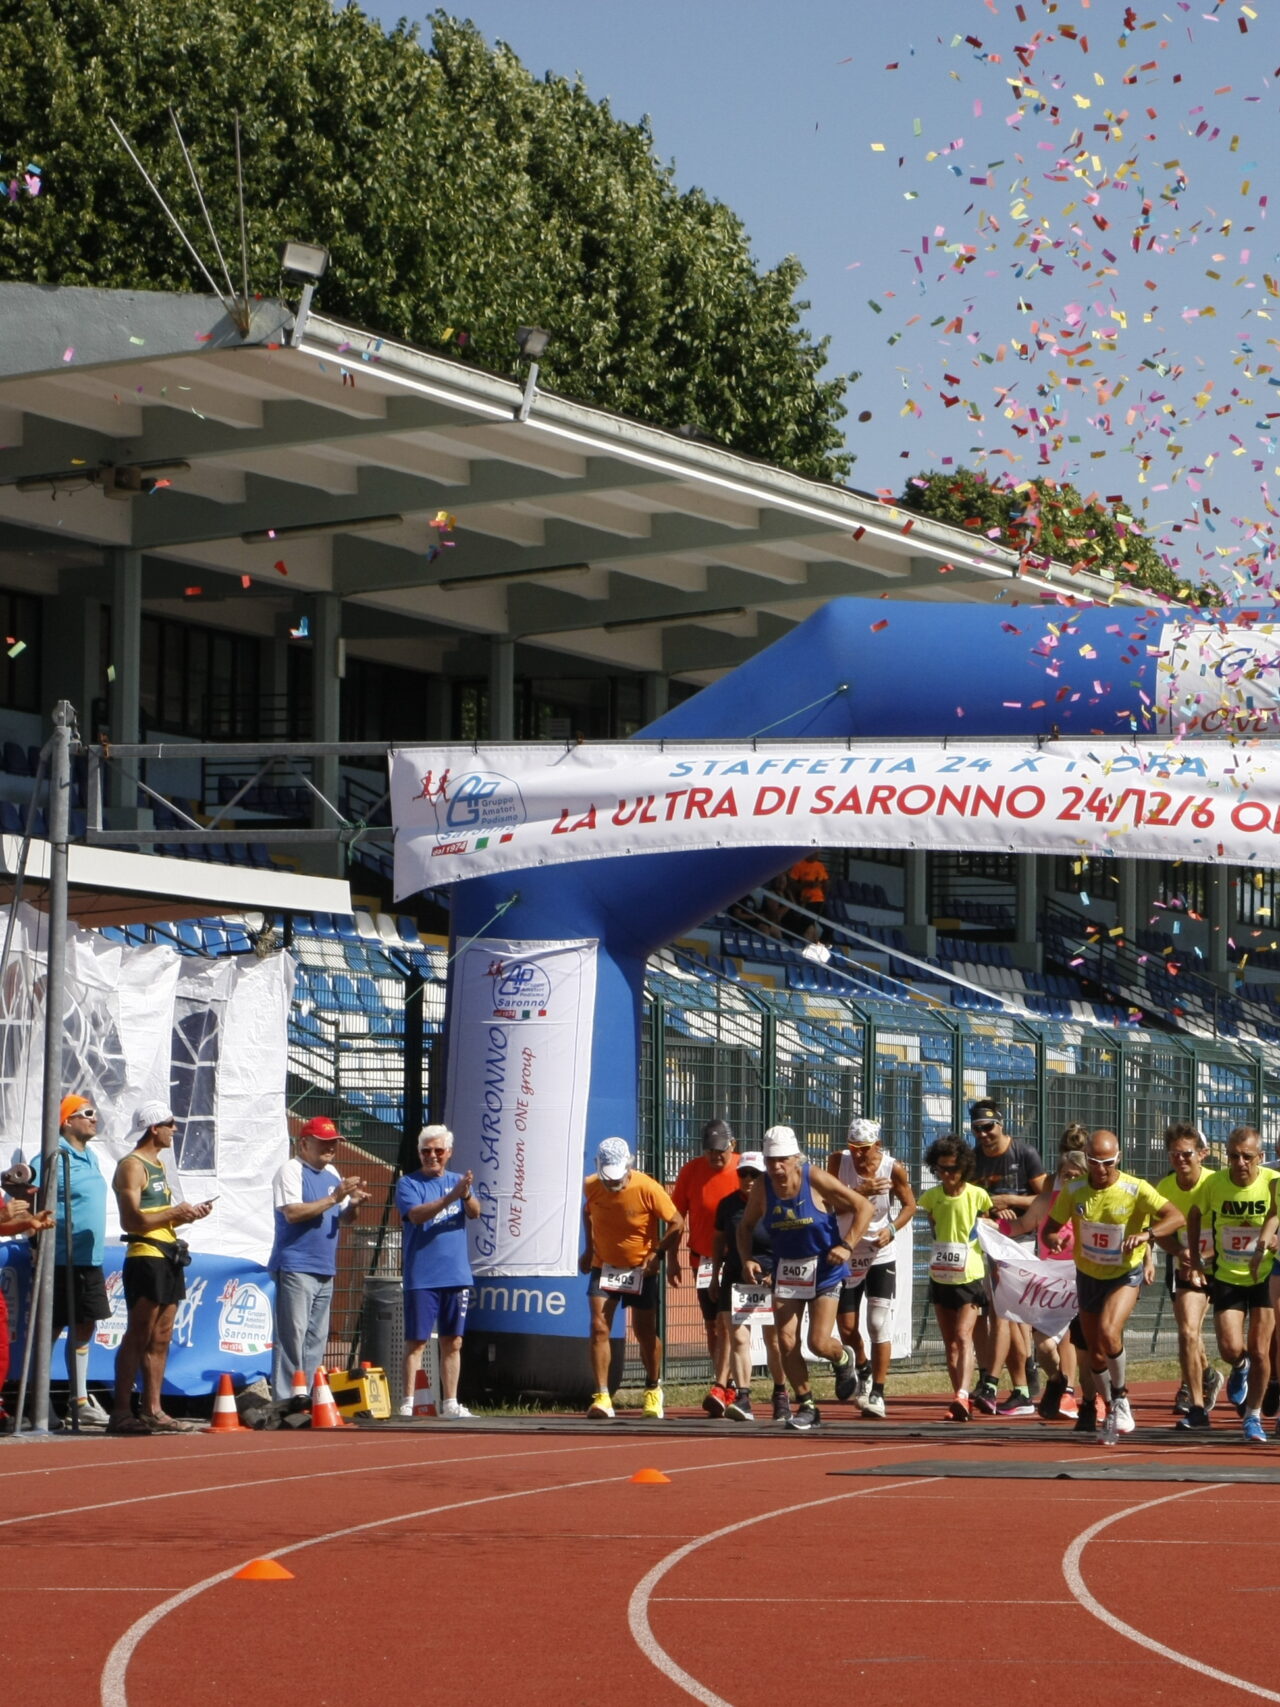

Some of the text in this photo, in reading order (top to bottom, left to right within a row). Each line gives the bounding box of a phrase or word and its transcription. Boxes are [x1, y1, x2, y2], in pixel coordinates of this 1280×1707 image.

[668, 756, 918, 778] STAFFETTA
[937, 756, 994, 774] 24
[1105, 754, 1209, 778] ORA
[481, 797, 514, 808] Gruppo
[550, 803, 598, 835] LA
[611, 786, 739, 827] ULTRA
[752, 785, 802, 816] DI
[809, 783, 1046, 819] SARONNO
[1056, 785, 1216, 829] 24/12/6
[481, 806, 516, 817] Amatori
[444, 841, 468, 854] 1974
[497, 998, 546, 1007] Saronno
[474, 1026, 508, 1258] G.A.P. SARONNO
[508, 1046, 537, 1238] ONE passion ONE group
[1221, 1199, 1267, 1215] AVIS
[1091, 1232, 1109, 1249] 15
[1231, 1236, 1252, 1250] 27
[782, 1265, 809, 1277] 2407
[607, 1273, 635, 1286] 2403
[224, 1327, 267, 1342] Saronno
